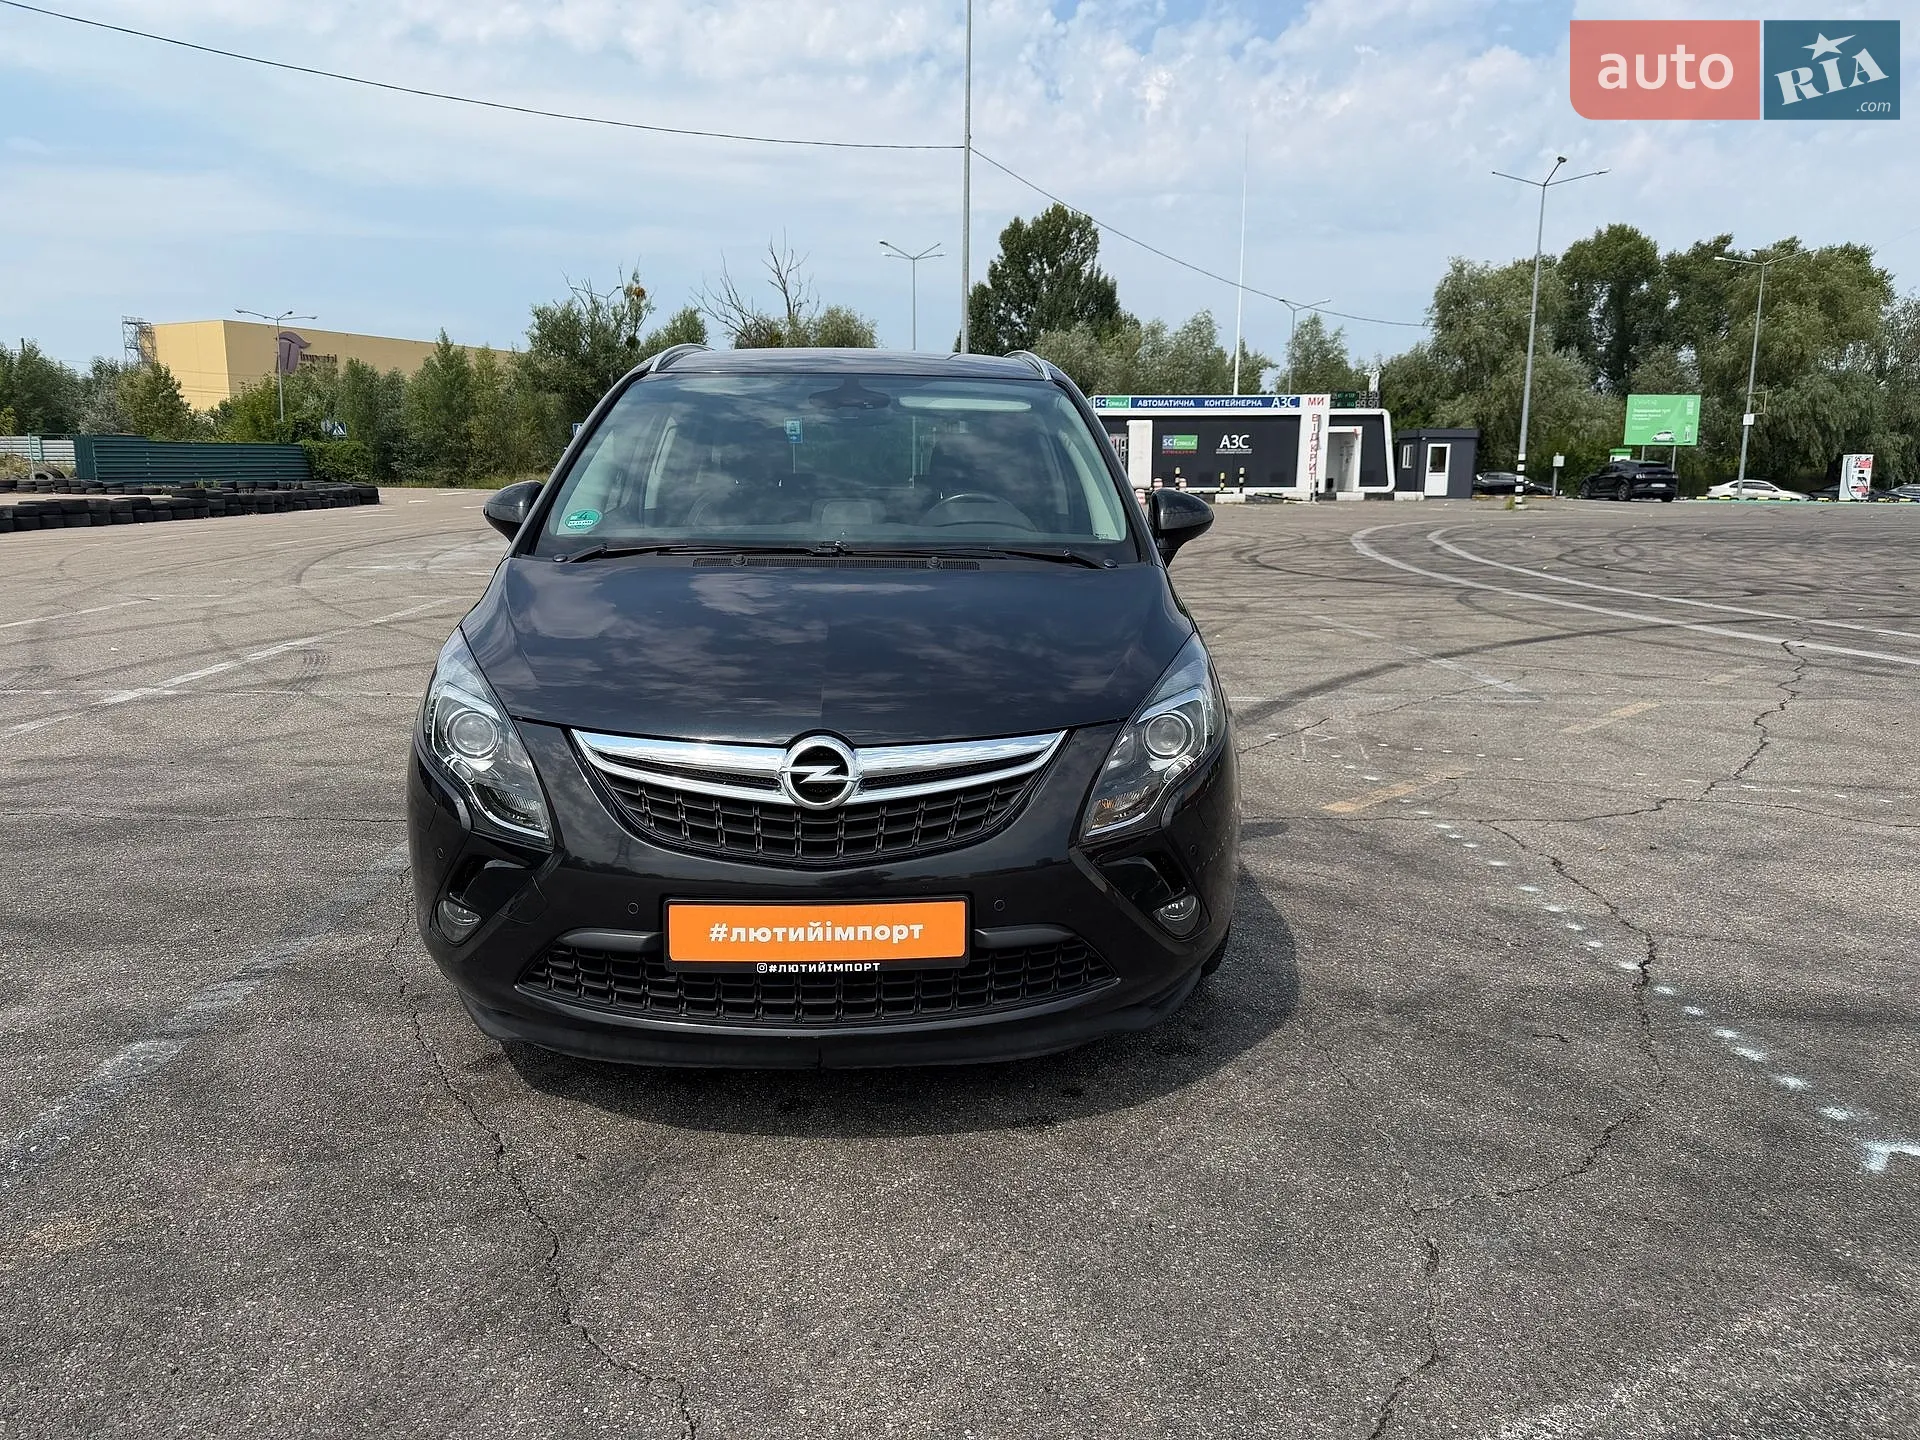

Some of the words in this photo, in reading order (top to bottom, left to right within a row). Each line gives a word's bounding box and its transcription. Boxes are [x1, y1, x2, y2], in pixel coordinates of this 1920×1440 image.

[1137, 399, 1195, 407] АВТОМАТИЧНА
[1204, 398, 1263, 407] КОНТЕЙНЕРНА
[1271, 397, 1296, 408] АЗС
[1308, 397, 1325, 406] МИ
[1219, 434, 1250, 449] АЗС
[708, 920, 924, 945] #лютийімпорт
